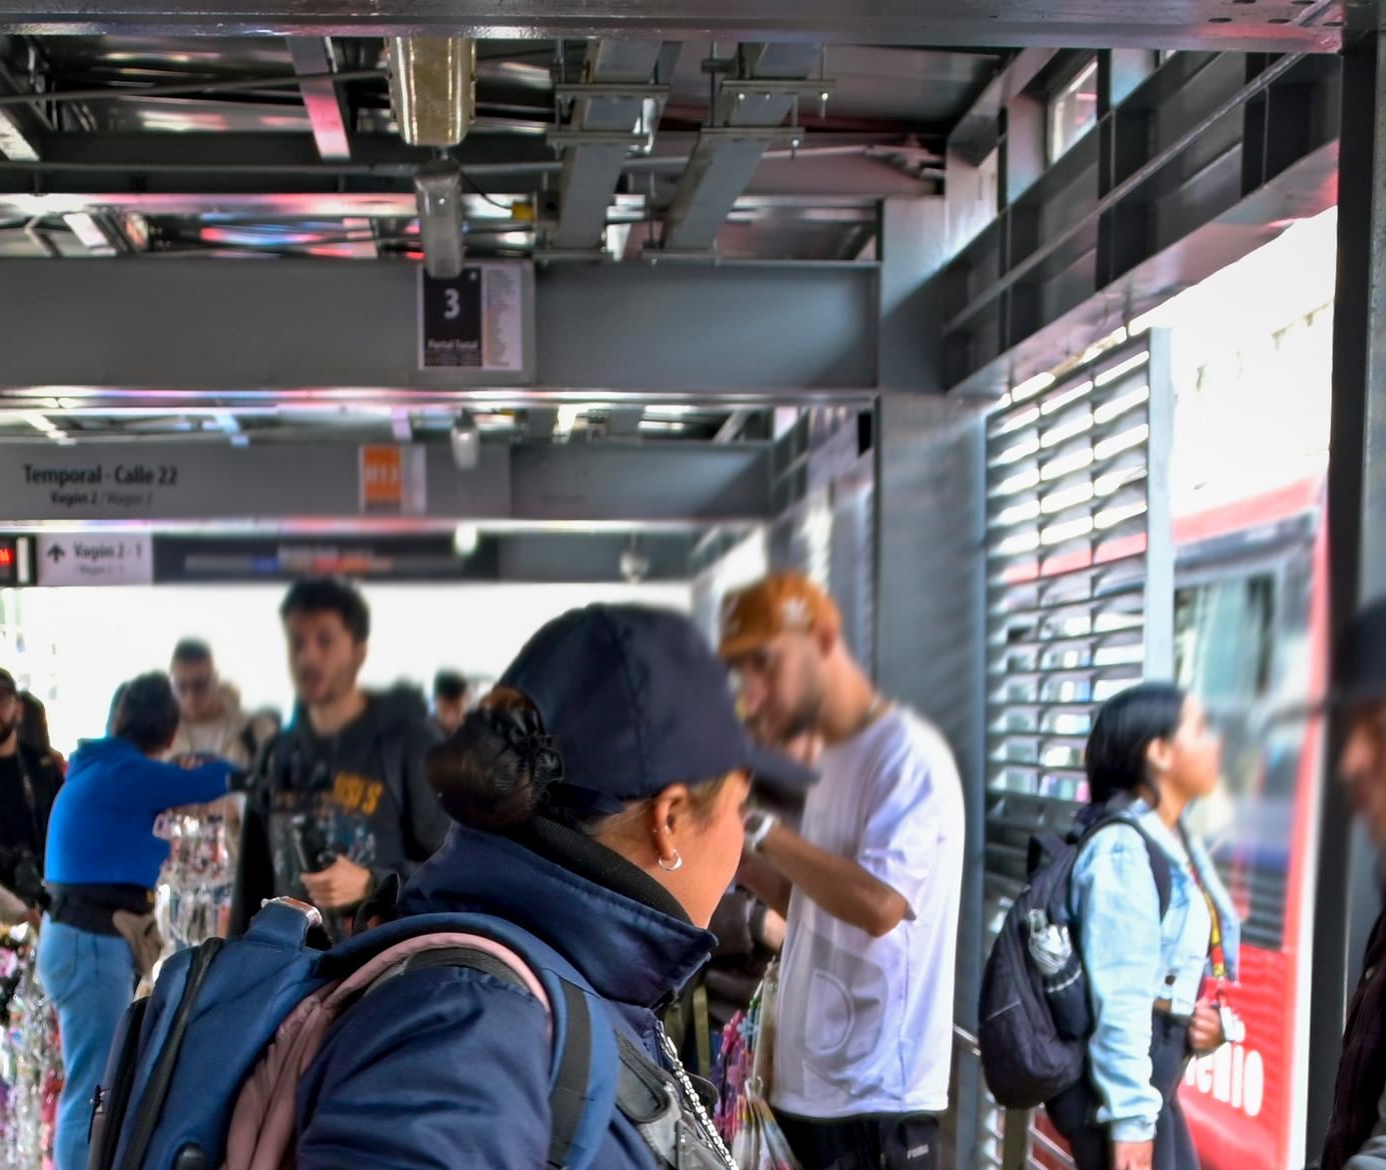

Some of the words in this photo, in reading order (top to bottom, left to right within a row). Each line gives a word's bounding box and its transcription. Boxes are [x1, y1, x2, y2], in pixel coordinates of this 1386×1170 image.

[444, 287, 461, 319] 3
[23, 464, 102, 487] Temporal
[115, 464, 154, 484] Calle
[158, 465, 178, 484] 22
